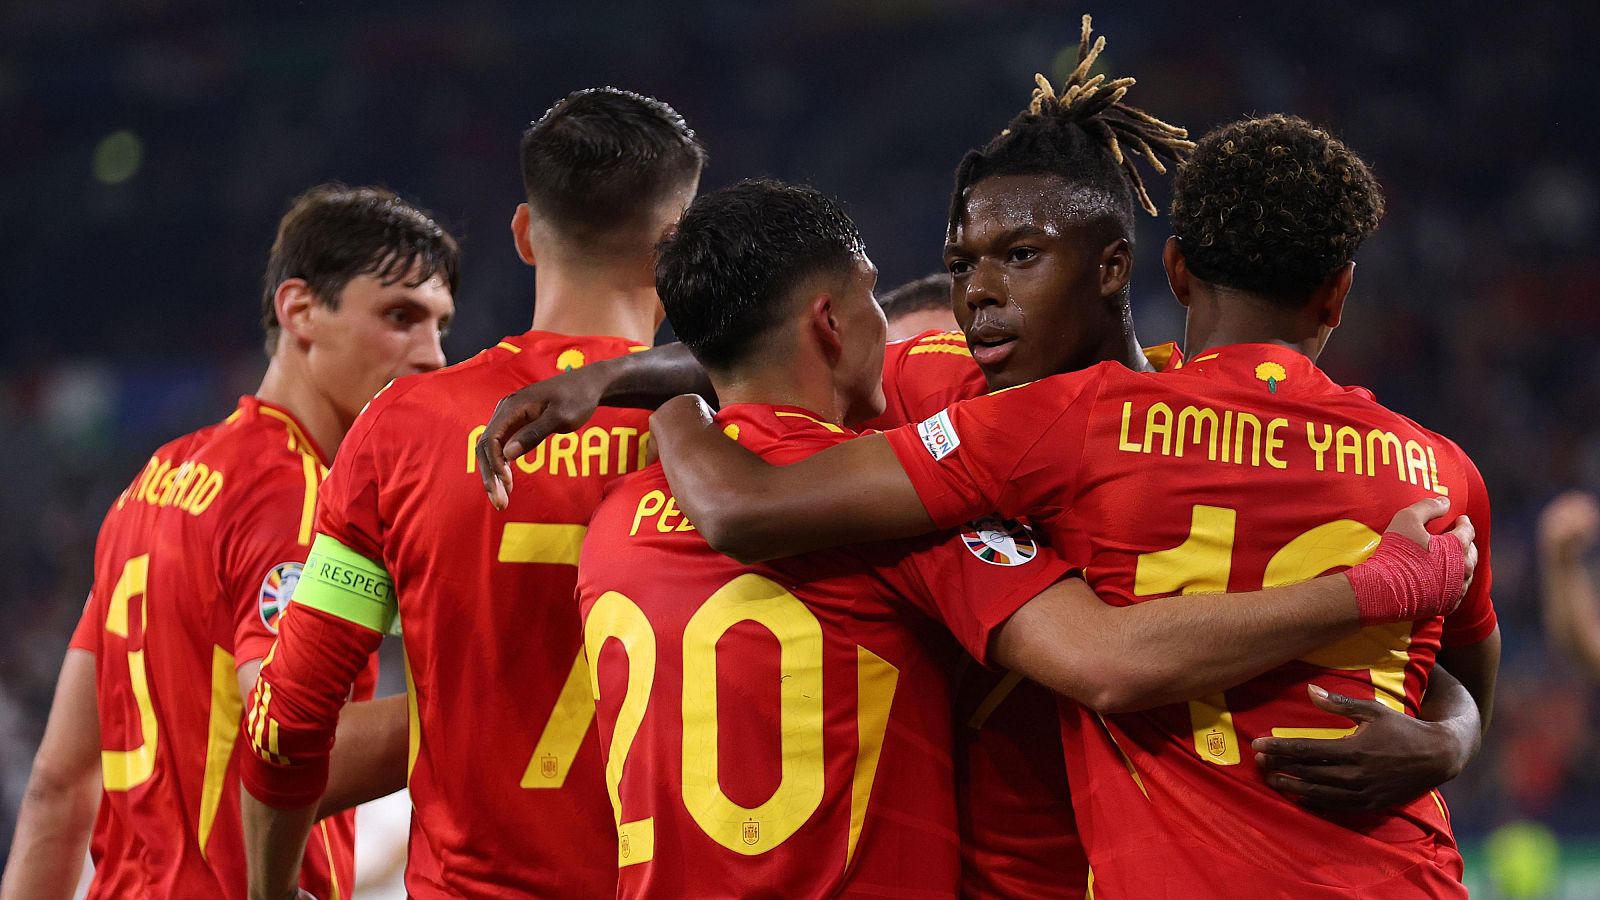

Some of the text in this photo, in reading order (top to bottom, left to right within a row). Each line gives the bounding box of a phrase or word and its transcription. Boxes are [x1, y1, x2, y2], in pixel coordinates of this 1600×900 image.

[1118, 401, 1449, 496] LAMINE YAMAL
[319, 562, 395, 600] RESPECT
[497, 521, 598, 789] 7
[584, 572, 826, 869] 20
